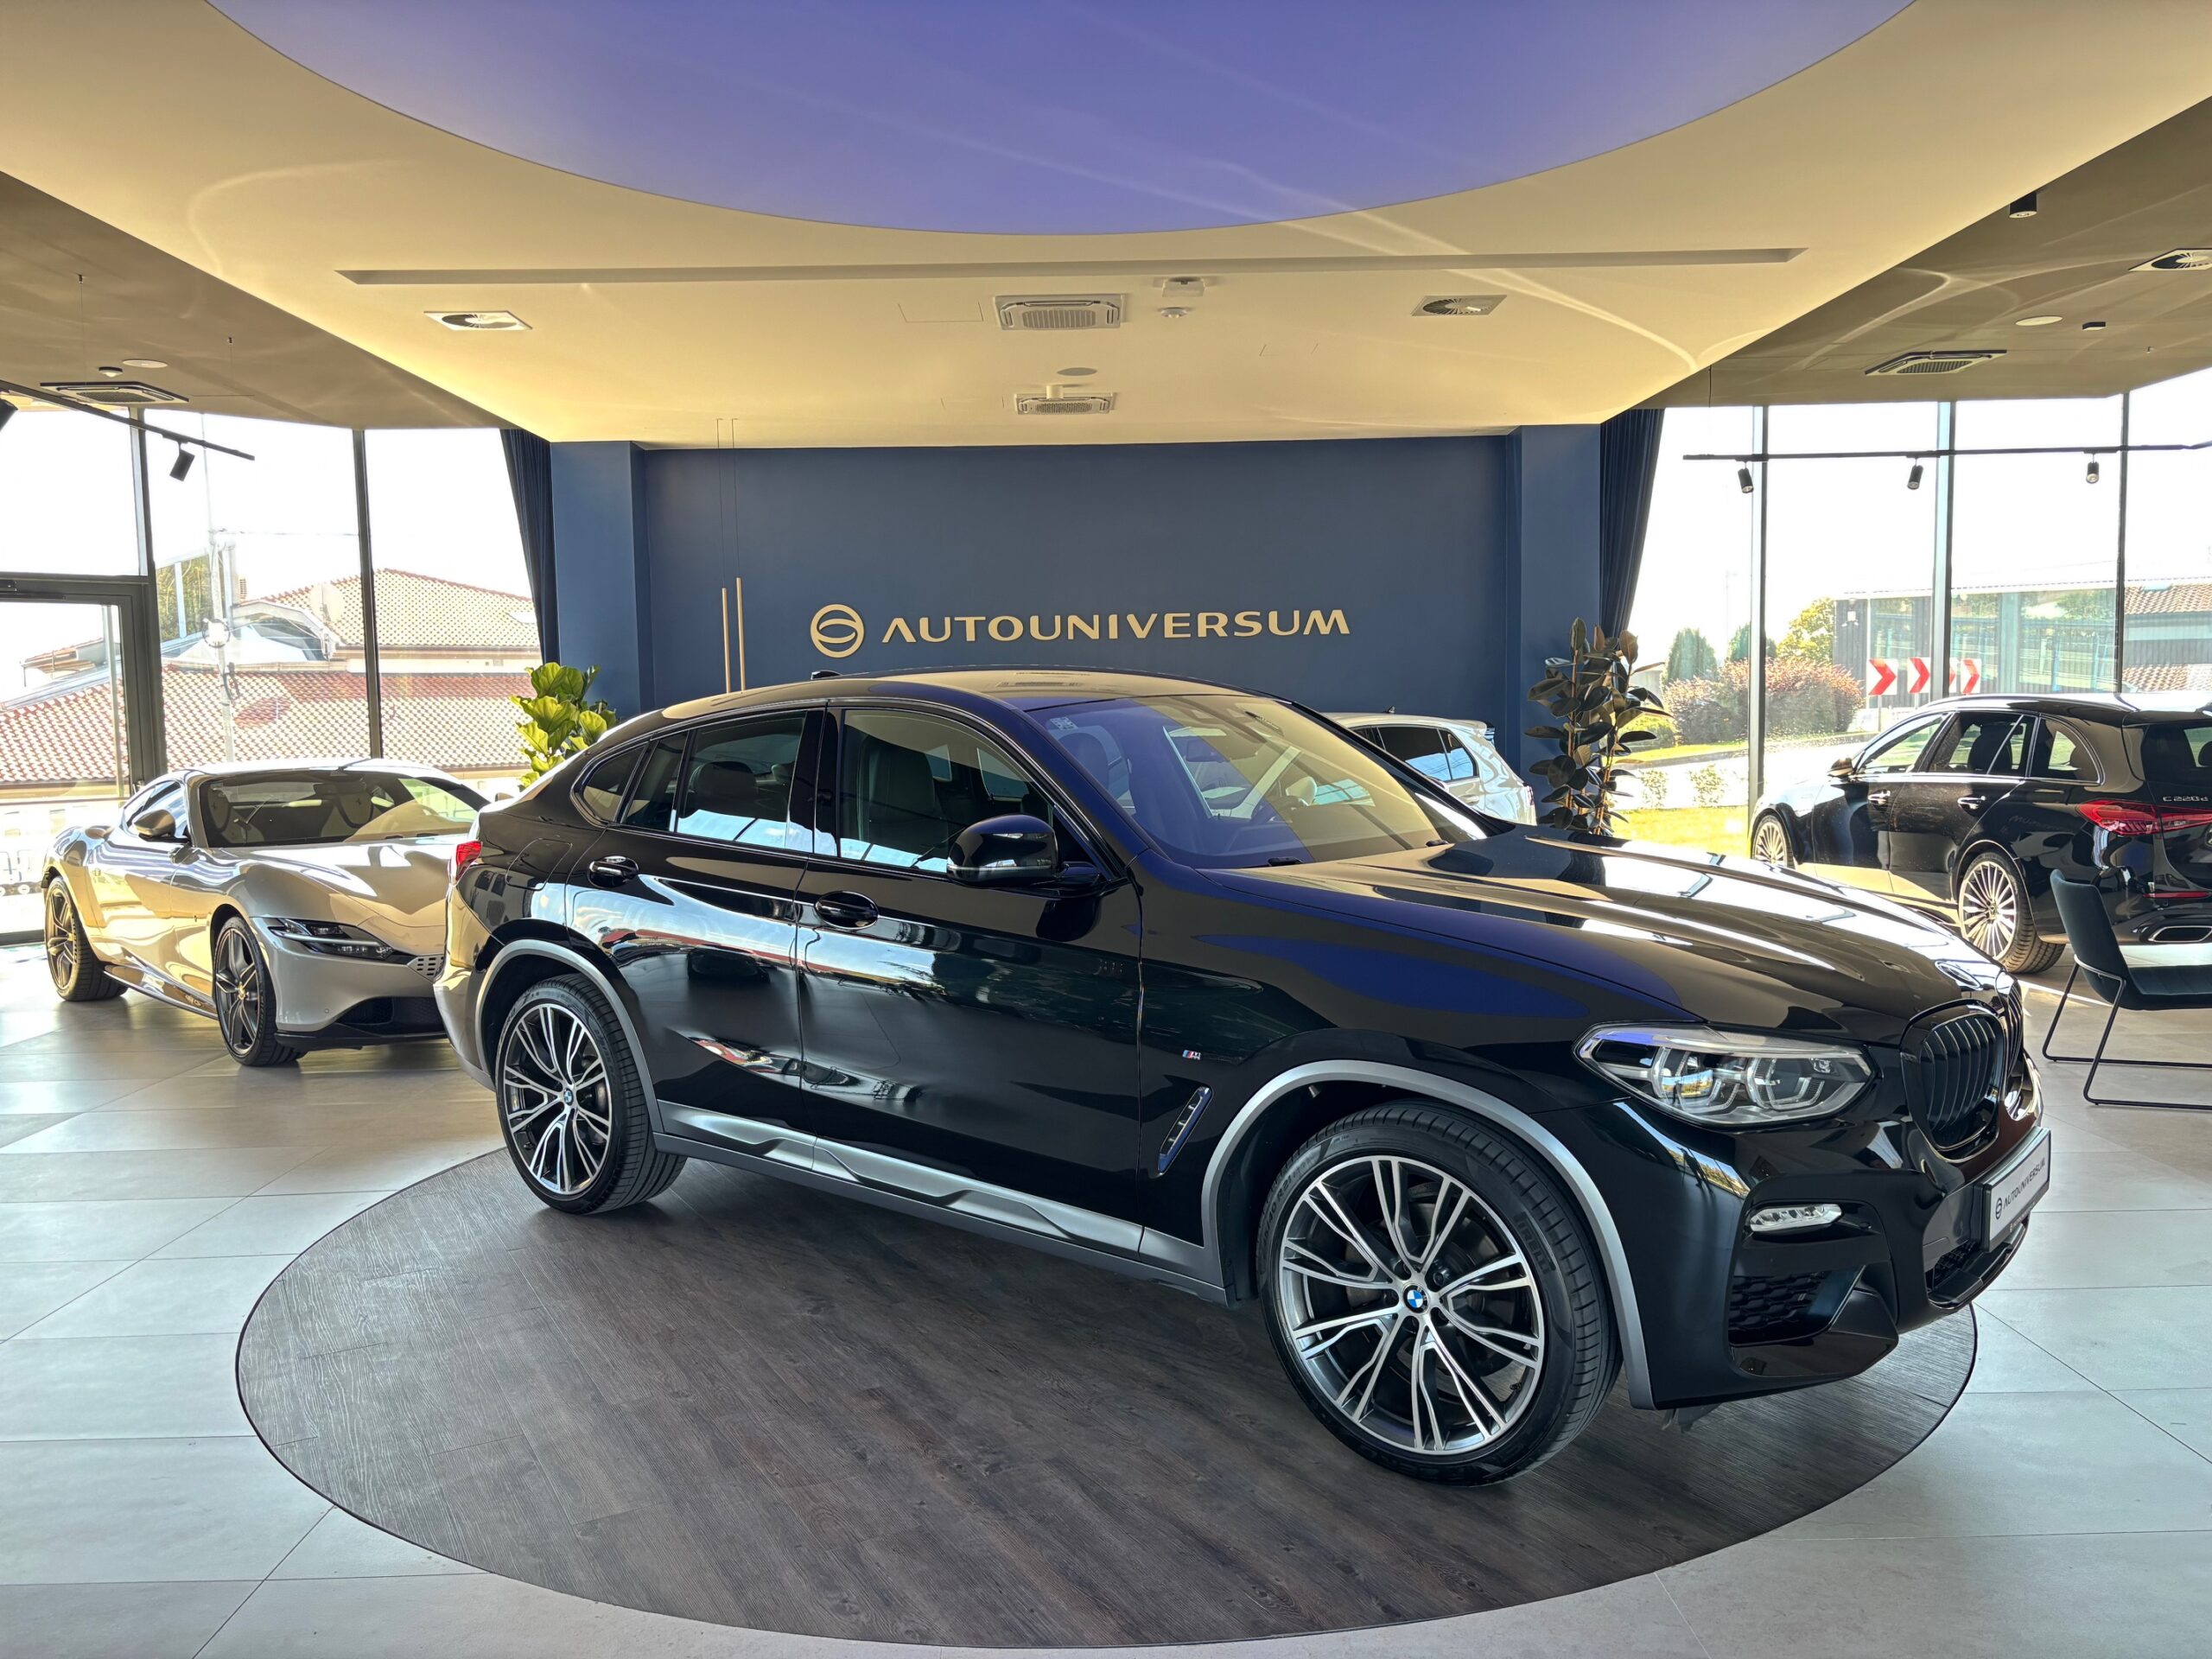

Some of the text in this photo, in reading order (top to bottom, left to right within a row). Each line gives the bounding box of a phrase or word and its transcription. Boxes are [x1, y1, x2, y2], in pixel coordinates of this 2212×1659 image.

[881, 608, 1351, 644] AUTOUNIVERSUM
[2003, 1157, 2046, 1209] AUTOUNIVERSUM
[1513, 1211, 1556, 1274] PIRELLI
